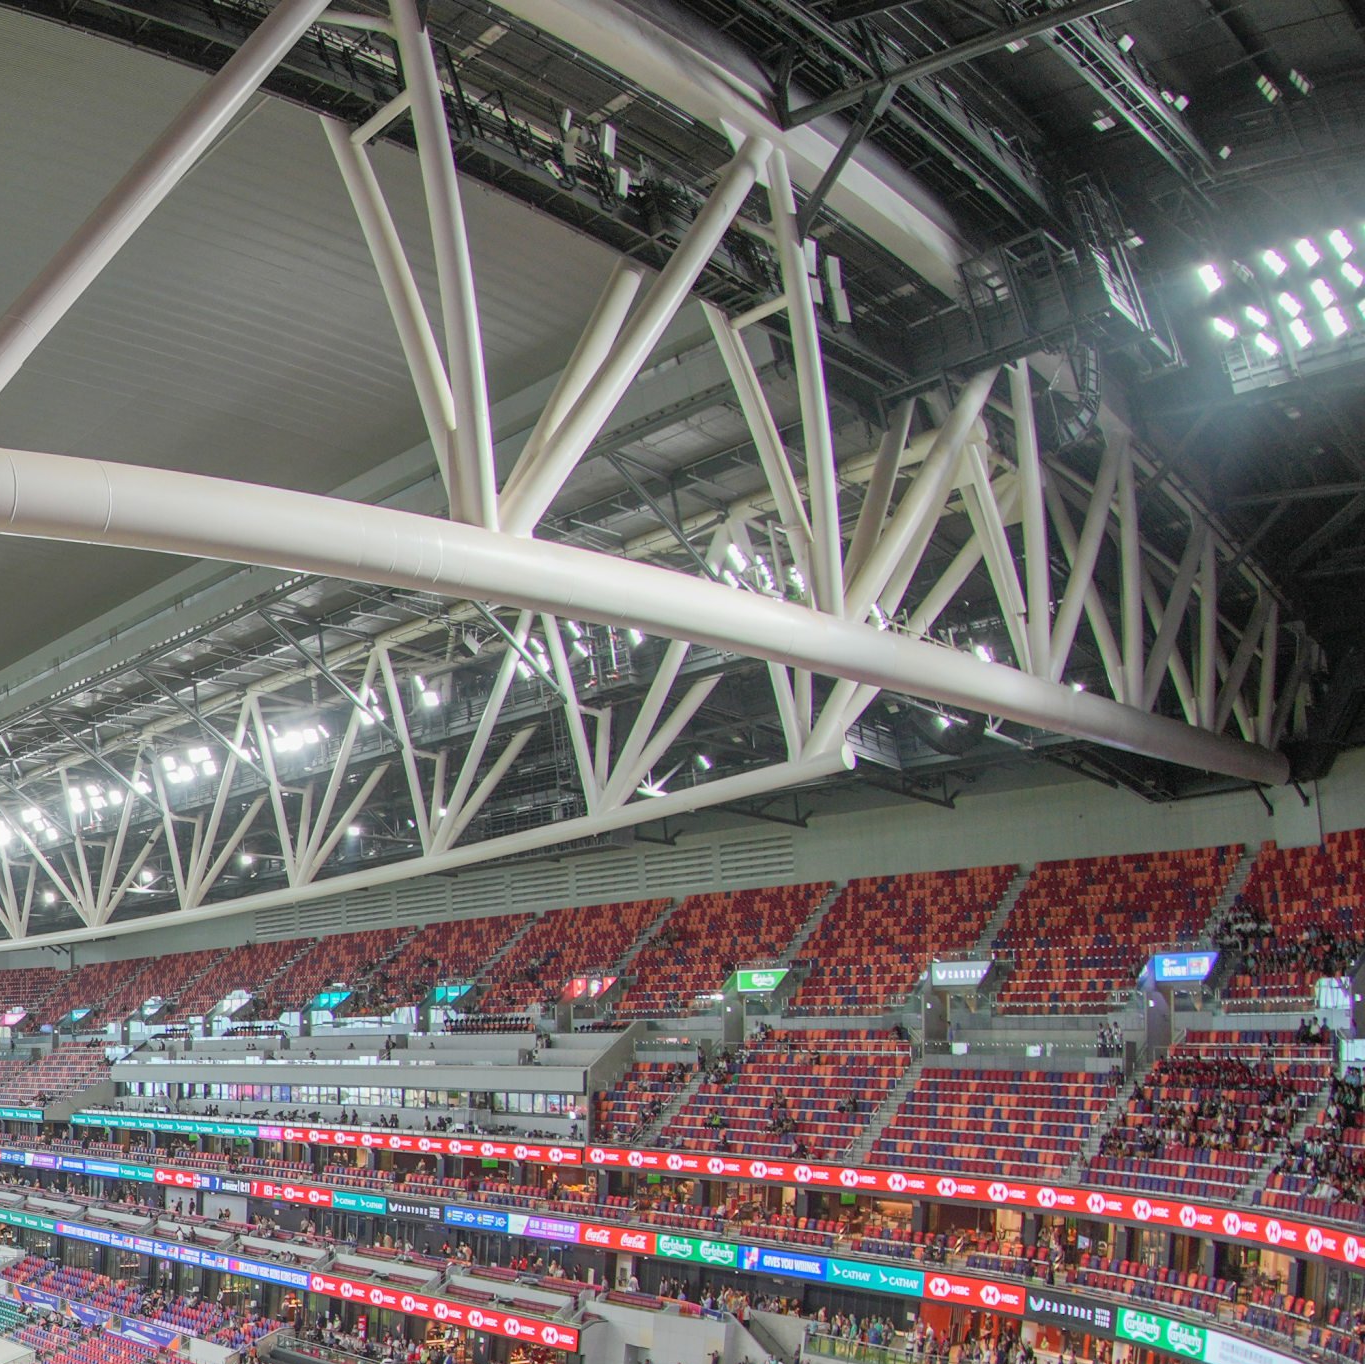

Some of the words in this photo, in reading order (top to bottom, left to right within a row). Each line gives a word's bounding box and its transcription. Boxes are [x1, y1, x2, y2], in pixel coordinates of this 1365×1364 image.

[683, 1160, 698, 1168] HSBC
[768, 1167, 784, 1176] HSBC
[813, 1171, 829, 1180] HSBC
[215, 1178, 220, 1189] 7
[859, 1175, 877, 1184] HSBC
[908, 1180, 925, 1189] HSBC
[252, 1183, 257, 1195] 7
[957, 1185, 976, 1194] HSBC
[1008, 1190, 1026, 1199] HSBC
[1058, 1195, 1075, 1205] HSBC
[1105, 1201, 1122, 1210] HSBC
[1152, 1207, 1169, 1218] HSBC
[1196, 1214, 1213, 1225] HSBC
[585, 1228, 610, 1244] Coca-Cola
[620, 1233, 647, 1250] Coca-Cola
[659, 1236, 693, 1258] Carlsberg
[700, 1241, 734, 1264] Carlsberg
[763, 1255, 780, 1267] GIVES
[780, 1257, 793, 1269] YOU
[842, 1269, 871, 1282] CATHAY
[890, 1276, 918, 1290] CATHAY
[950, 1286, 970, 1296] HSBC
[1001, 1294, 1019, 1305] HSBC
[415, 1302, 428, 1312] HSBC
[1044, 1301, 1093, 1321] CASTORE
[449, 1309, 462, 1319] HSBC
[483, 1317, 498, 1327] HSBC
[520, 1326, 535, 1336] HSBC
[1124, 1310, 1161, 1343] Carlsberg
[1168, 1321, 1203, 1355] Carlsberg
[558, 1335, 574, 1345] HSBC
